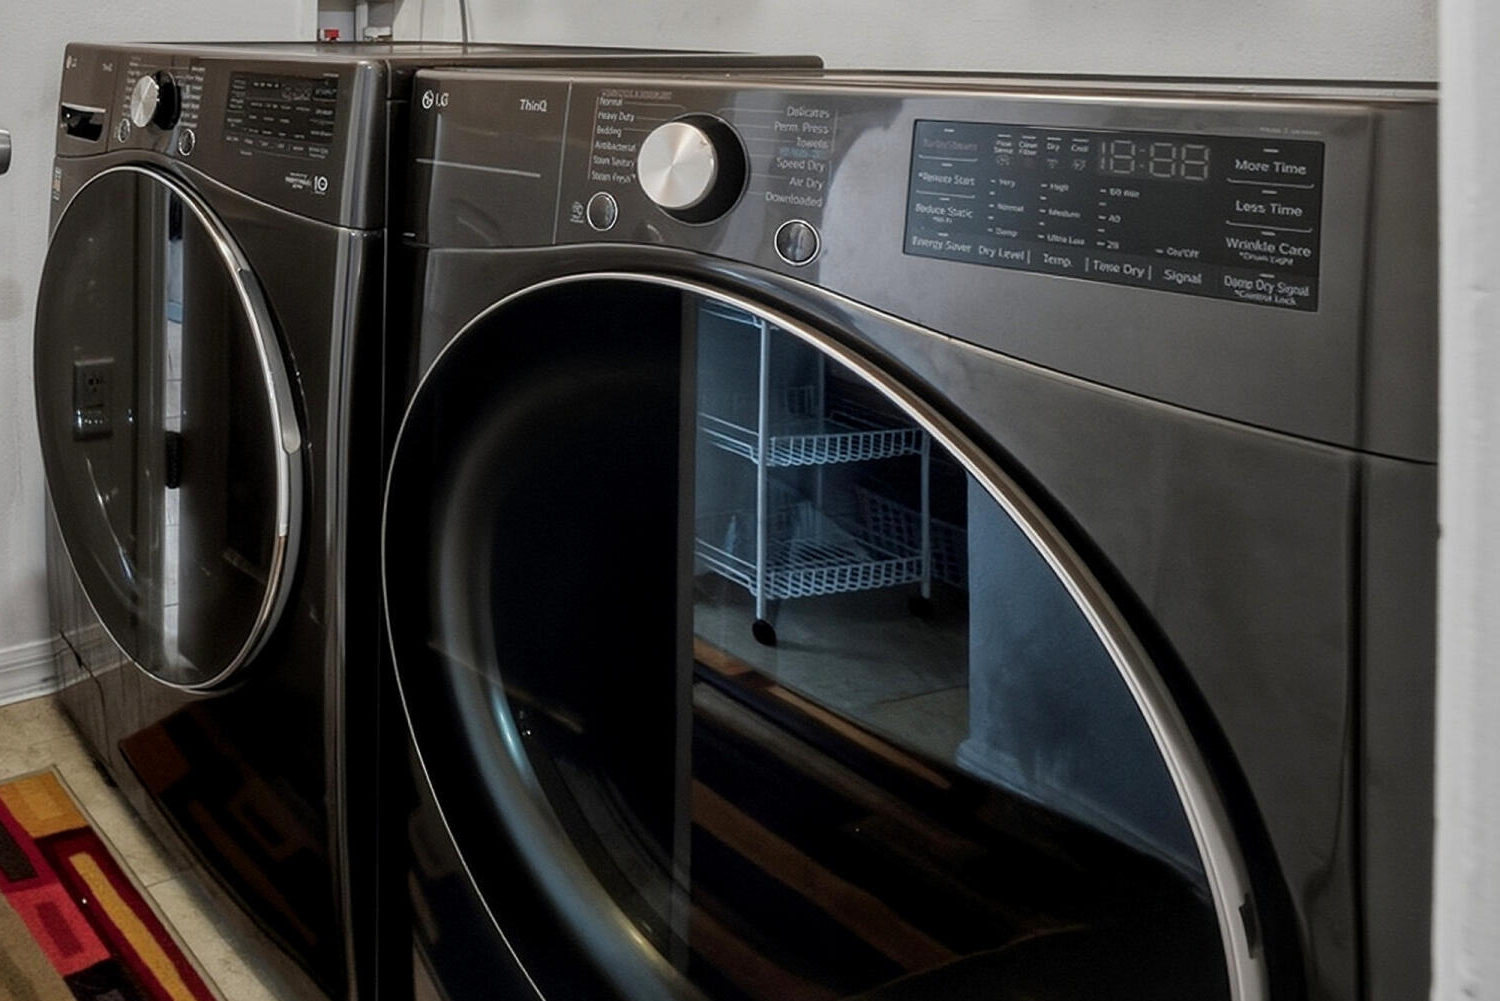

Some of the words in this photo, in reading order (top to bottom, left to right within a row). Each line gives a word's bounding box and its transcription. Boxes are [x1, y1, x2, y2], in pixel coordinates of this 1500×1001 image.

[434, 91, 450, 107] LG
[519, 98, 548, 113] ThinQ
[599, 96, 623, 107] Normal
[597, 111, 618, 122] Heavy
[618, 112, 635, 123] Duty
[786, 105, 830, 119] Delicates
[596, 124, 622, 138] Bedding
[802, 121, 830, 135] Press
[1046, 143, 1061, 153] Dry
[776, 157, 806, 170] Speed
[807, 159, 826, 173] Dry
[1235, 158, 1270, 173] More
[1273, 161, 1307, 176] Time
[789, 176, 804, 187] Air
[806, 177, 823, 192] Dry
[953, 174, 977, 187] Start
[764, 191, 823, 208] Downloaded
[915, 202, 947, 216] Reduce
[947, 205, 974, 220] Static
[1235, 199, 1266, 215] Less
[1270, 202, 1303, 217] Time
[912, 235, 944, 251] Energy
[946, 240, 973, 254] Saver
[978, 244, 997, 259] Dry
[998, 247, 1026, 261] Level
[1226, 237, 1277, 254] Wrinkle
[1278, 242, 1312, 259] Care
[1093, 259, 1121, 274] Time
[1122, 263, 1146, 279] Dry
[1163, 268, 1203, 286] Signal
[1223, 274, 1254, 291] Damp
[1255, 278, 1275, 295] Dry
[1277, 281, 1310, 298] Signal
[1273, 293, 1297, 307] Lock
